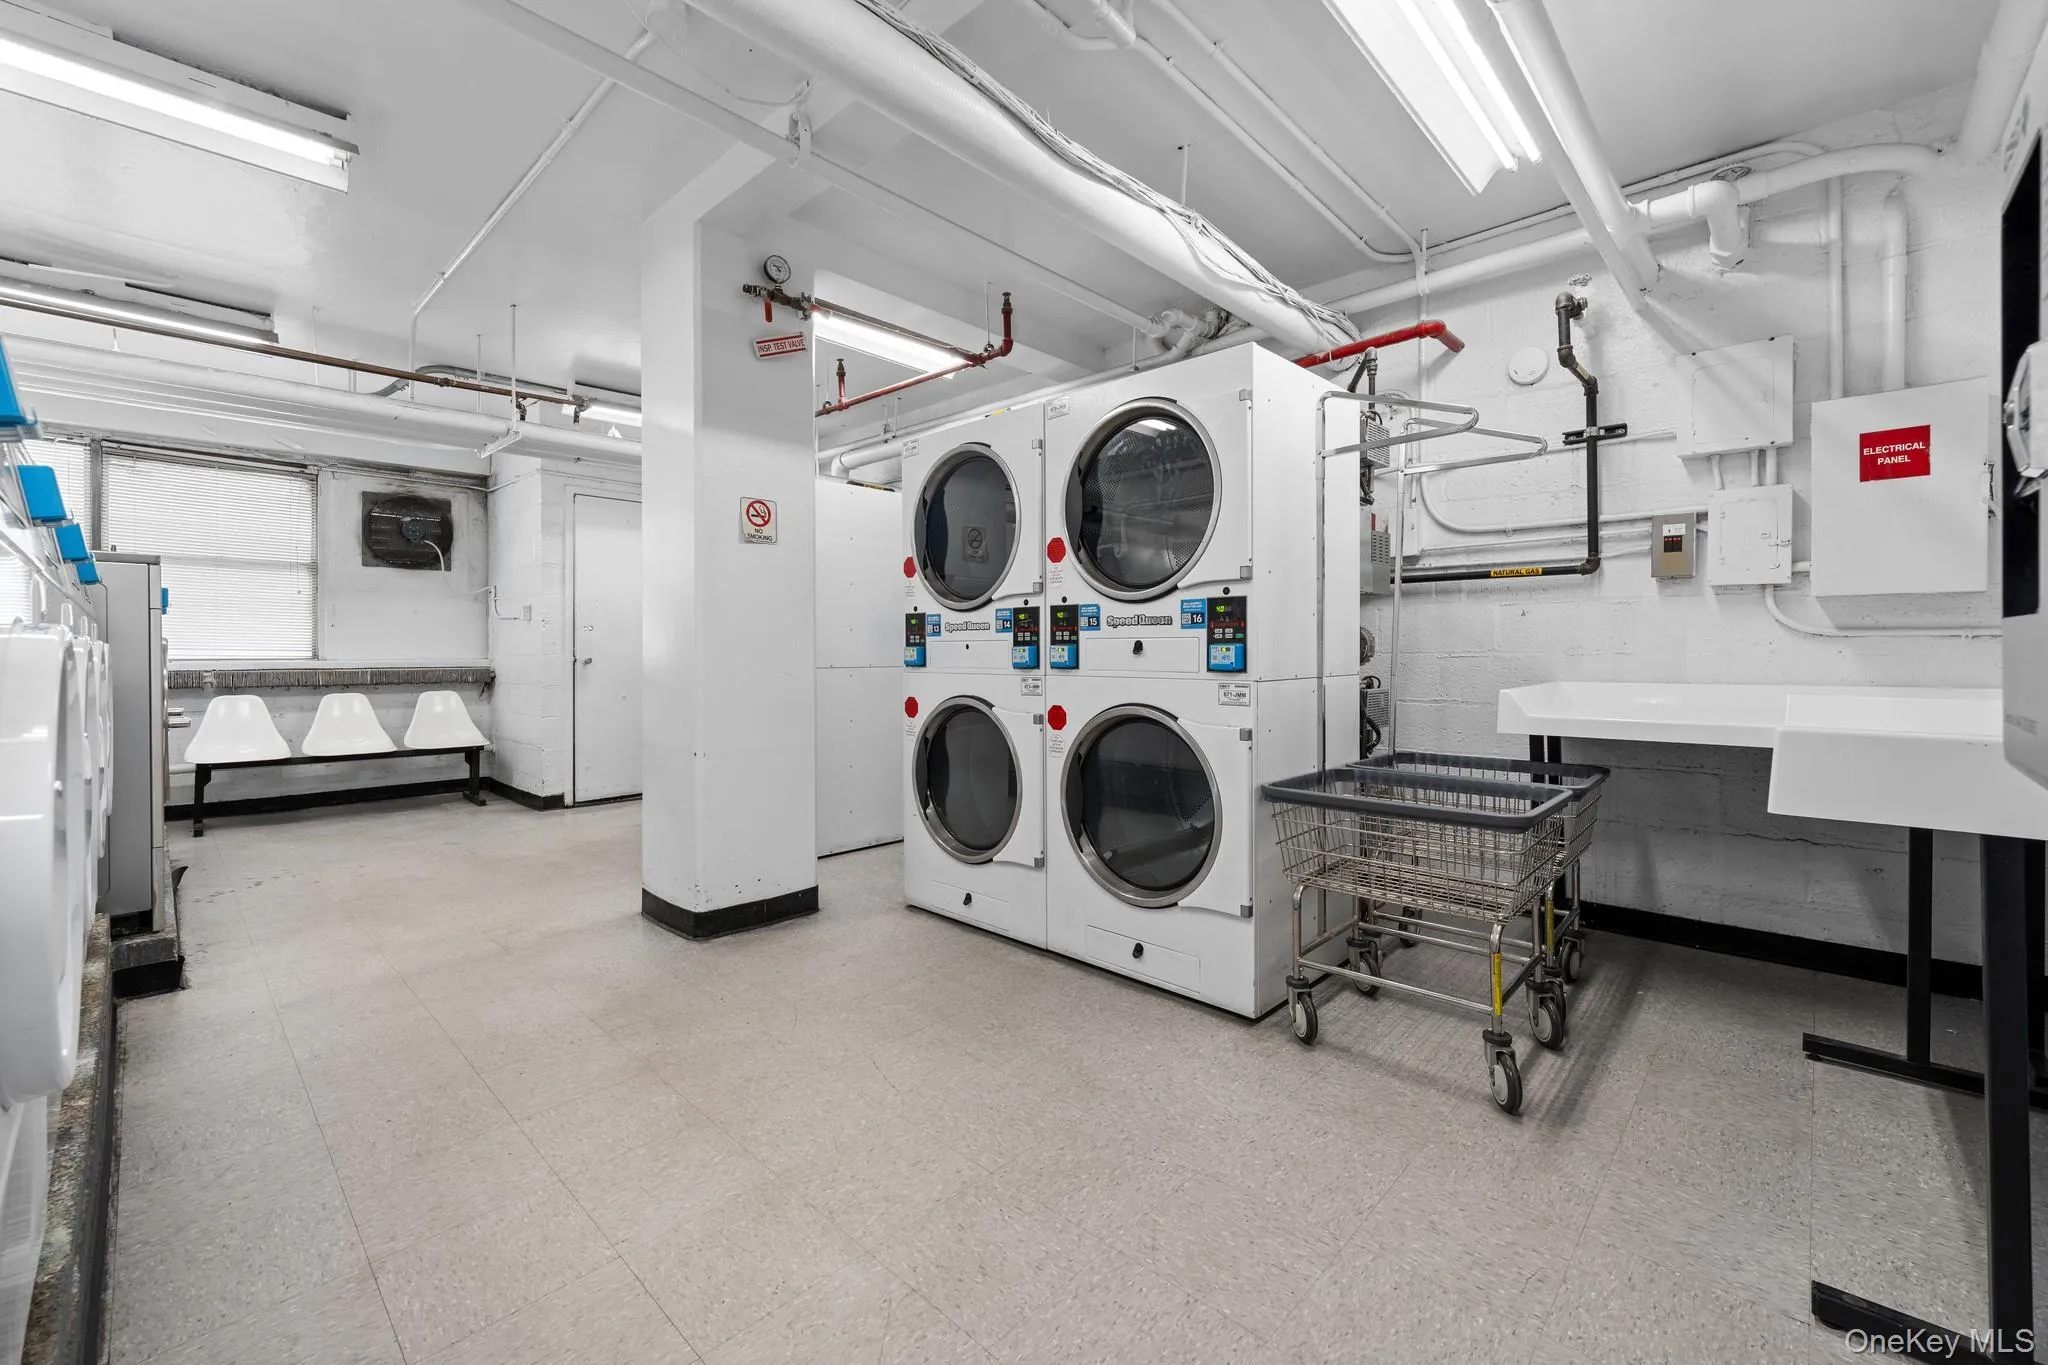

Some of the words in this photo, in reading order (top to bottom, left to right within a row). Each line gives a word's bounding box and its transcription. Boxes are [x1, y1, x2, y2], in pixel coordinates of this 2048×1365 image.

[758, 344, 773, 353] INSP.
[773, 342, 787, 350] TEST
[787, 339, 805, 348] VALVE
[1863, 441, 1926, 455] ELECTRICAL
[1877, 455, 1911, 465] PANEL
[746, 533, 772, 541] SMOKING
[1089, 618, 1097, 626] 15
[1107, 614, 1139, 628] Speed
[1139, 614, 1172, 626] Queen
[1193, 614, 1202, 623] 16
[945, 621, 966, 633] Speed
[967, 620, 990, 631] Queen
[1004, 620, 1010, 628] 14
